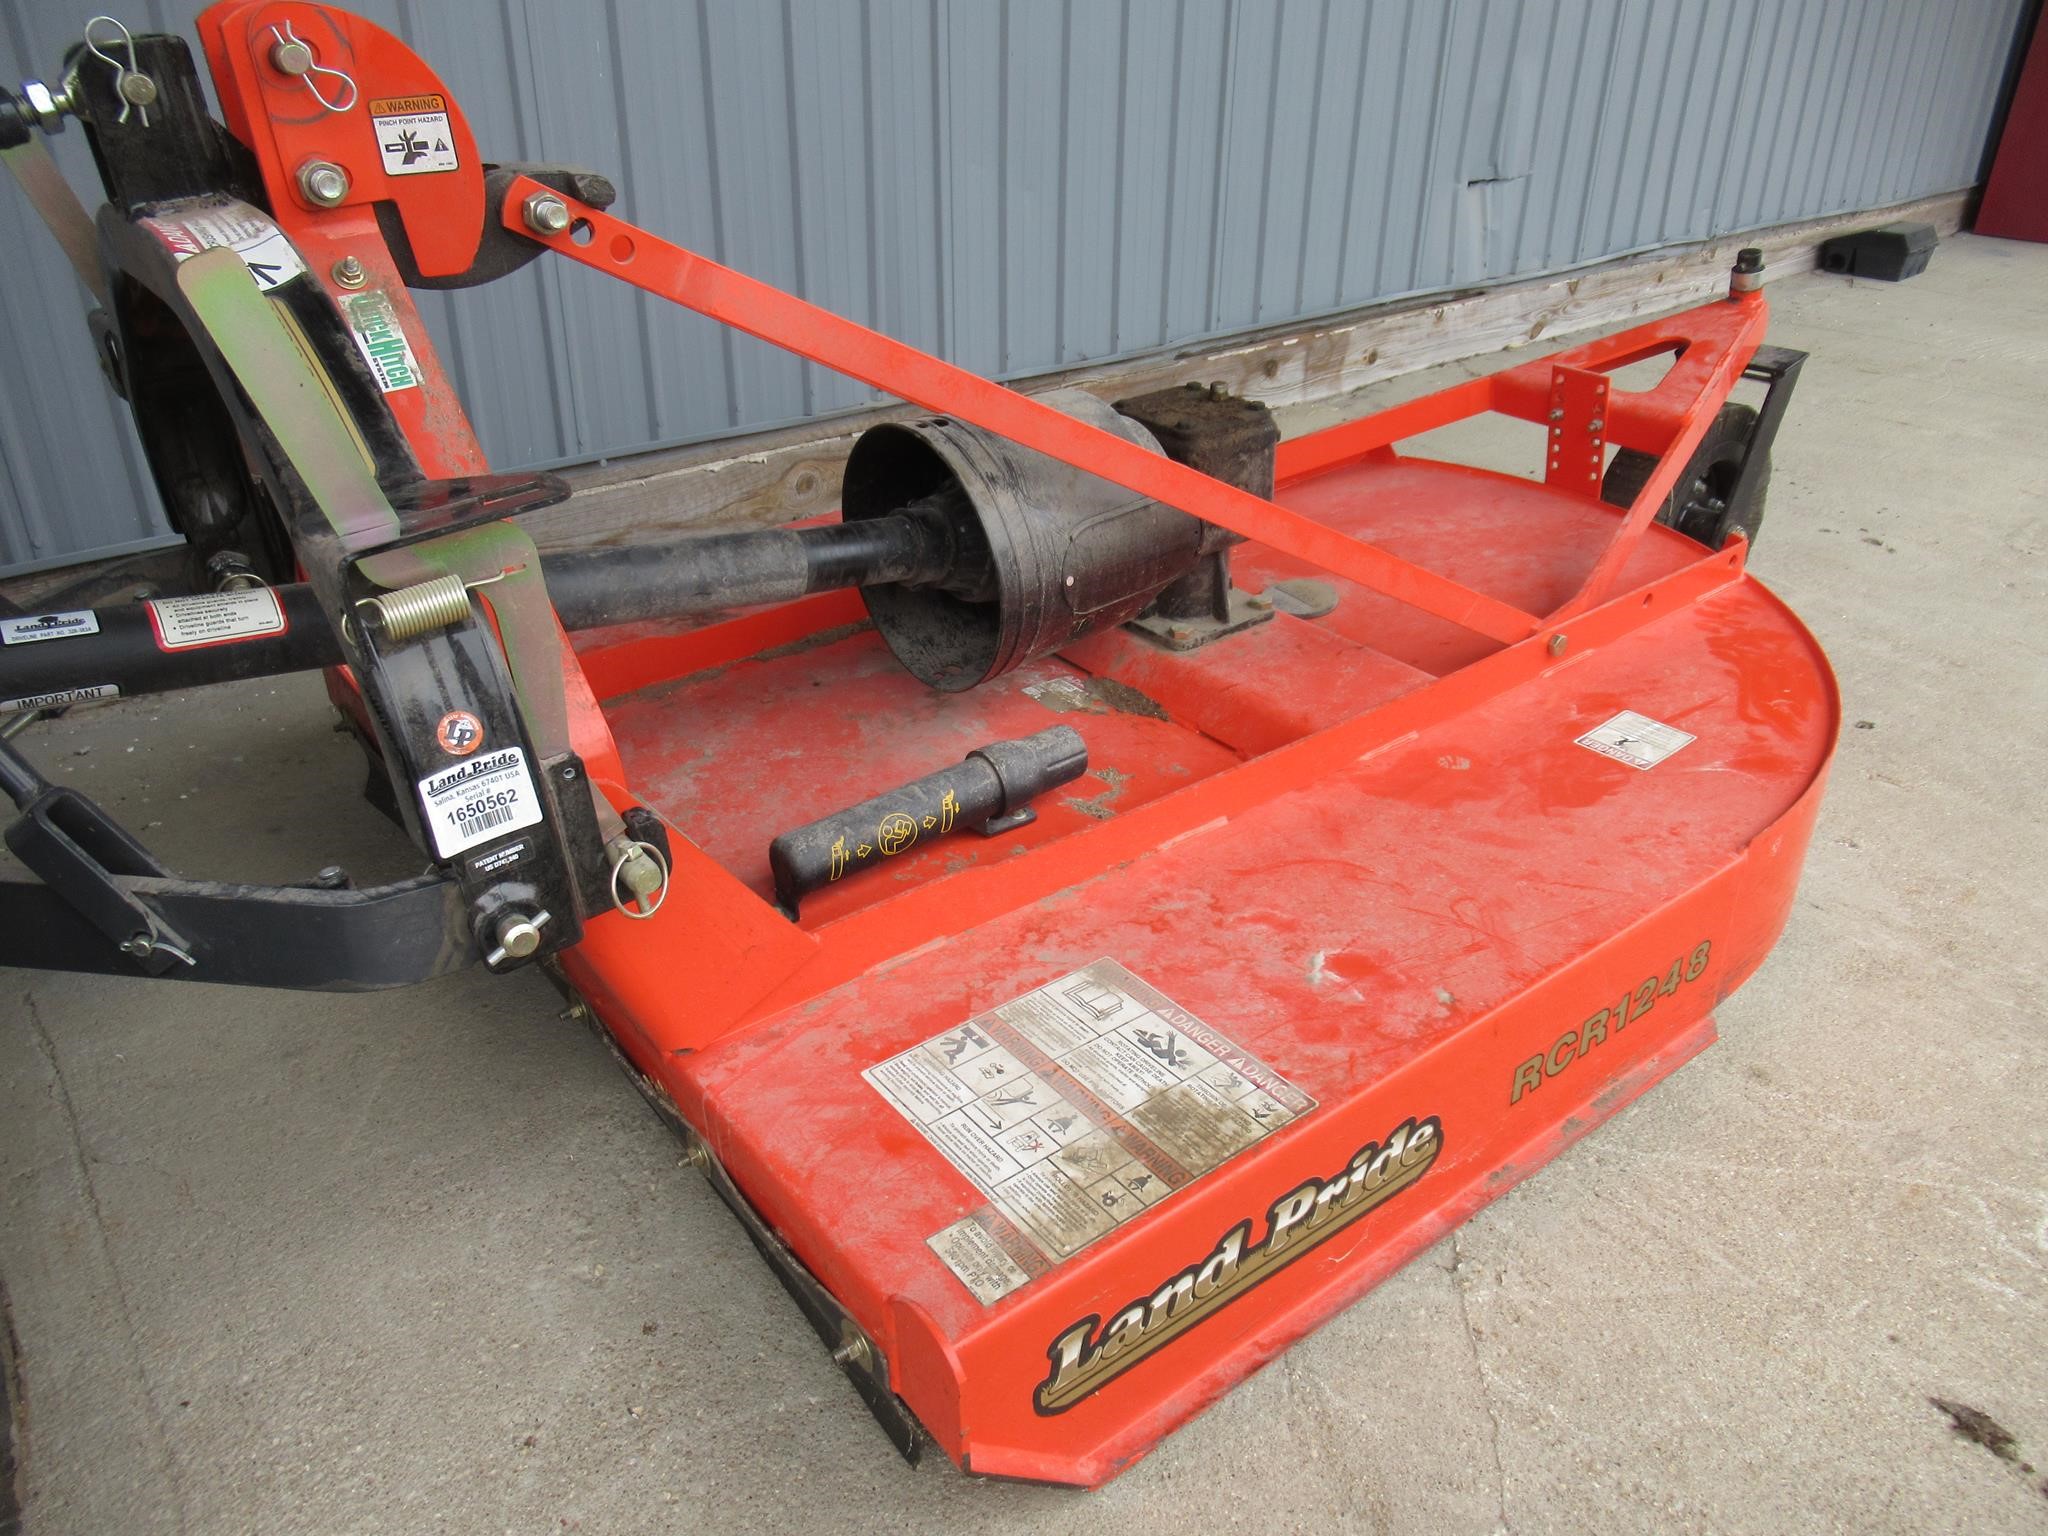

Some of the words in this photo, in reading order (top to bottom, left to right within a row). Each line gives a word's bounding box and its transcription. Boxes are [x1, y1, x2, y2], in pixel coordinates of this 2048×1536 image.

[385, 98, 439, 112] WARNING
[17, 687, 103, 710] IMPORTANT
[428, 767, 469, 795] Land
[472, 751, 519, 776] Pride
[456, 784, 480, 798] Kansas
[482, 776, 504, 788] 67401
[505, 770, 520, 780] USA
[447, 789, 518, 825] 1650562
[465, 790, 485, 802] Serial
[486, 787, 491, 795] #
[475, 854, 498, 868] PATENT
[1169, 1013, 1232, 1056] DANGER
[1510, 940, 1712, 1107] RCR1248
[988, 1025, 1045, 1067] WARNING
[1102, 1036, 1126, 1053] CONTACT
[1124, 1053, 1137, 1061] CAN
[1134, 1061, 1153, 1074] CAUSE
[1151, 1073, 1169, 1086] DEATH
[1114, 1052, 1129, 1063] KEEP
[1127, 1062, 1145, 1075] AWAY!
[1116, 1040, 1142, 1058] ROTATING
[1139, 1057, 1166, 1076] DRIVELINE
[1101, 1049, 1112, 1057] NOT
[1110, 1056, 1134, 1073] OPERATE
[1132, 1073, 1154, 1089] WITHOU
[1240, 1063, 1309, 1110] DANGER
[1051, 1076, 1113, 1123] WARNING
[959, 1122, 972, 1133] RUN
[969, 1132, 985, 1145] OVER
[982, 1143, 1004, 1162] HAZARD
[1119, 1132, 1188, 1186] WARNING
[956, 1229, 989, 1259] implement
[975, 1230, 992, 1249] avoid
[1049, 1224, 1249, 1393] Land
[1262, 1122, 1437, 1257] Pride
[954, 1260, 969, 1274] rpm
[986, 1275, 1001, 1290] with
